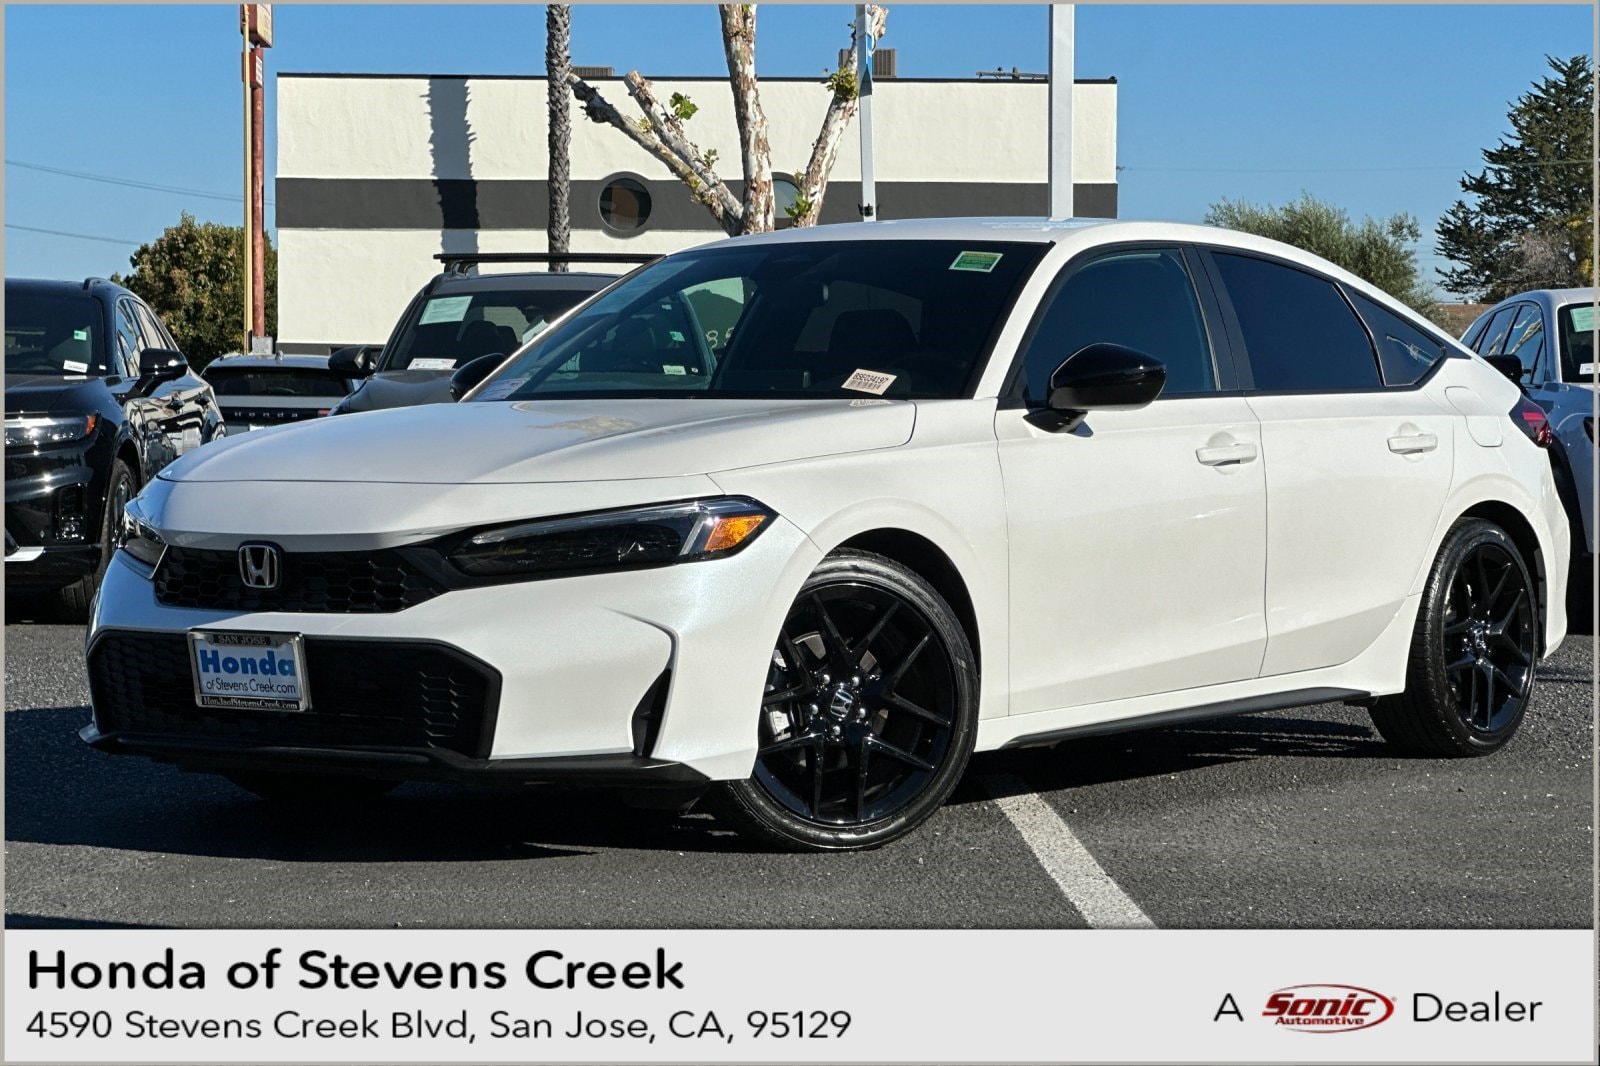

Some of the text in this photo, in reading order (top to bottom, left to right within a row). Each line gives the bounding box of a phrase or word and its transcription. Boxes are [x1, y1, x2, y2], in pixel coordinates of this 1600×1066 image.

[217, 635, 267, 645] SAN JOSE
[200, 649, 296, 676] Honda
[206, 677, 296, 693] of Stevens Creek.com
